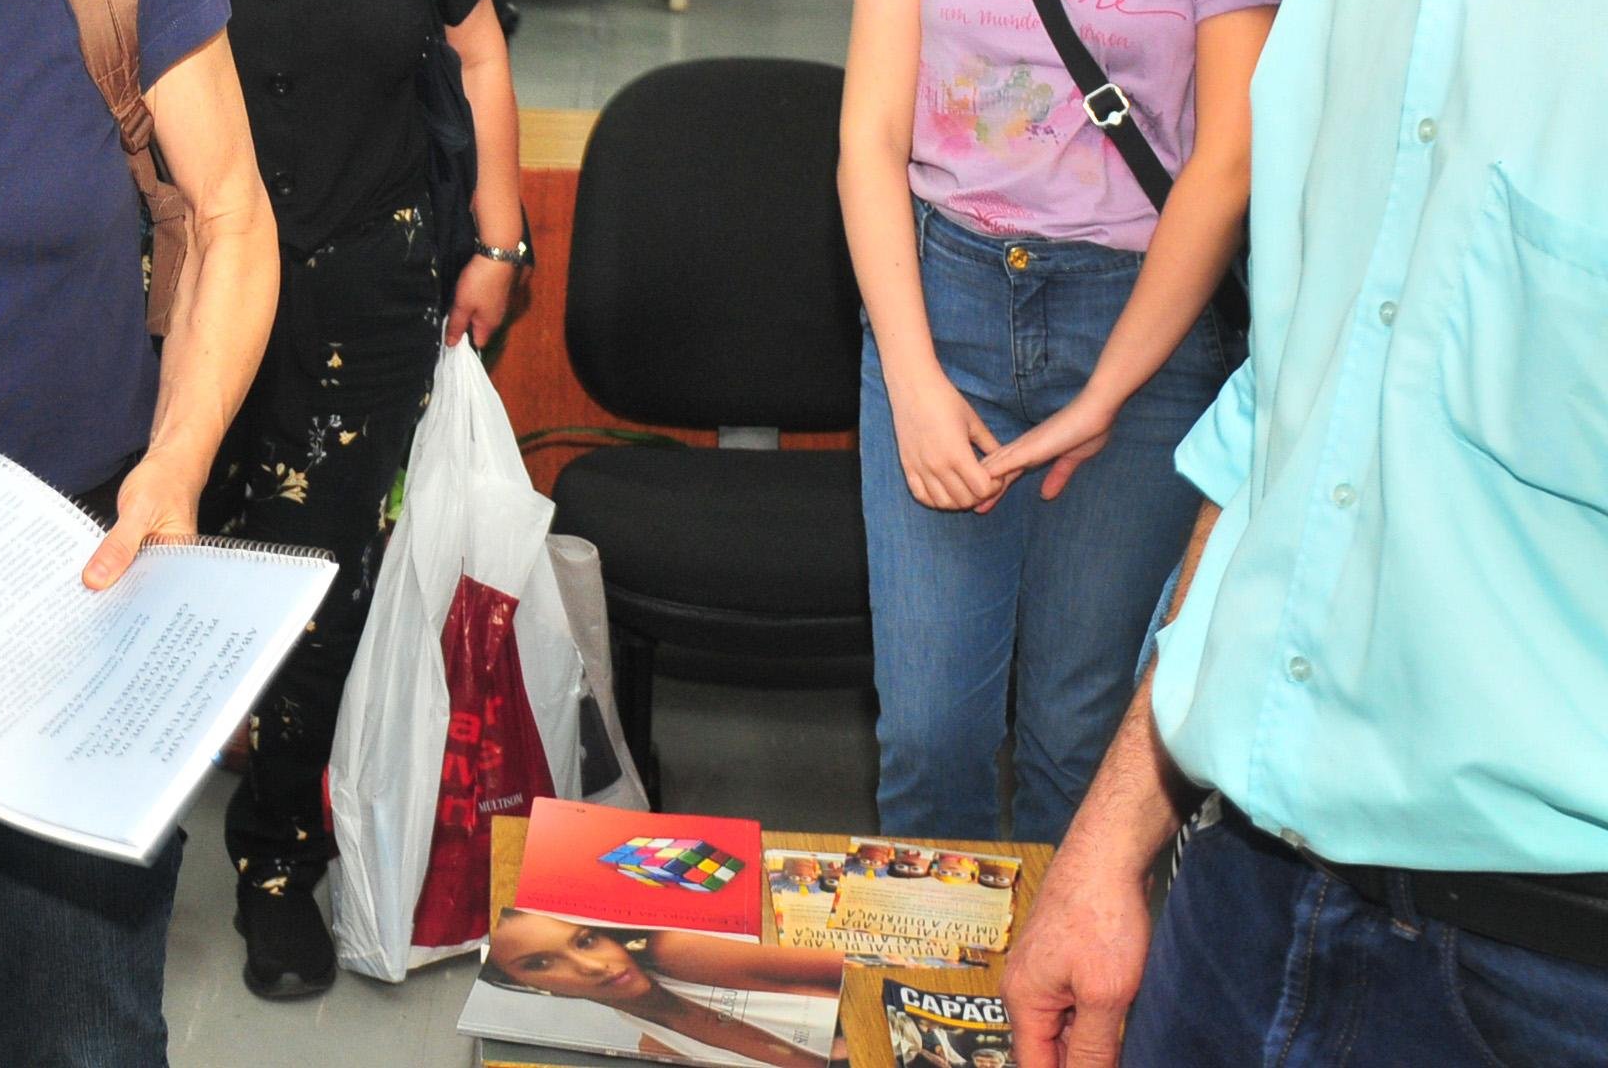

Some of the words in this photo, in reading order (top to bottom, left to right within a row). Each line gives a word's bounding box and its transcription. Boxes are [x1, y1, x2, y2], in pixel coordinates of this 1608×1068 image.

[478, 793, 524, 813] MULTISOM
[847, 909, 926, 926] DIFERENÇA
[841, 918, 884, 931] CADA
[893, 924, 908, 934] DE
[976, 924, 999, 936] UM
[917, 927, 981, 944] DIGITAL
[792, 937, 836, 949] CADA
[845, 941, 861, 951] DE
[869, 943, 934, 957] DIGITAL
[900, 987, 1011, 1023] CAPAC
